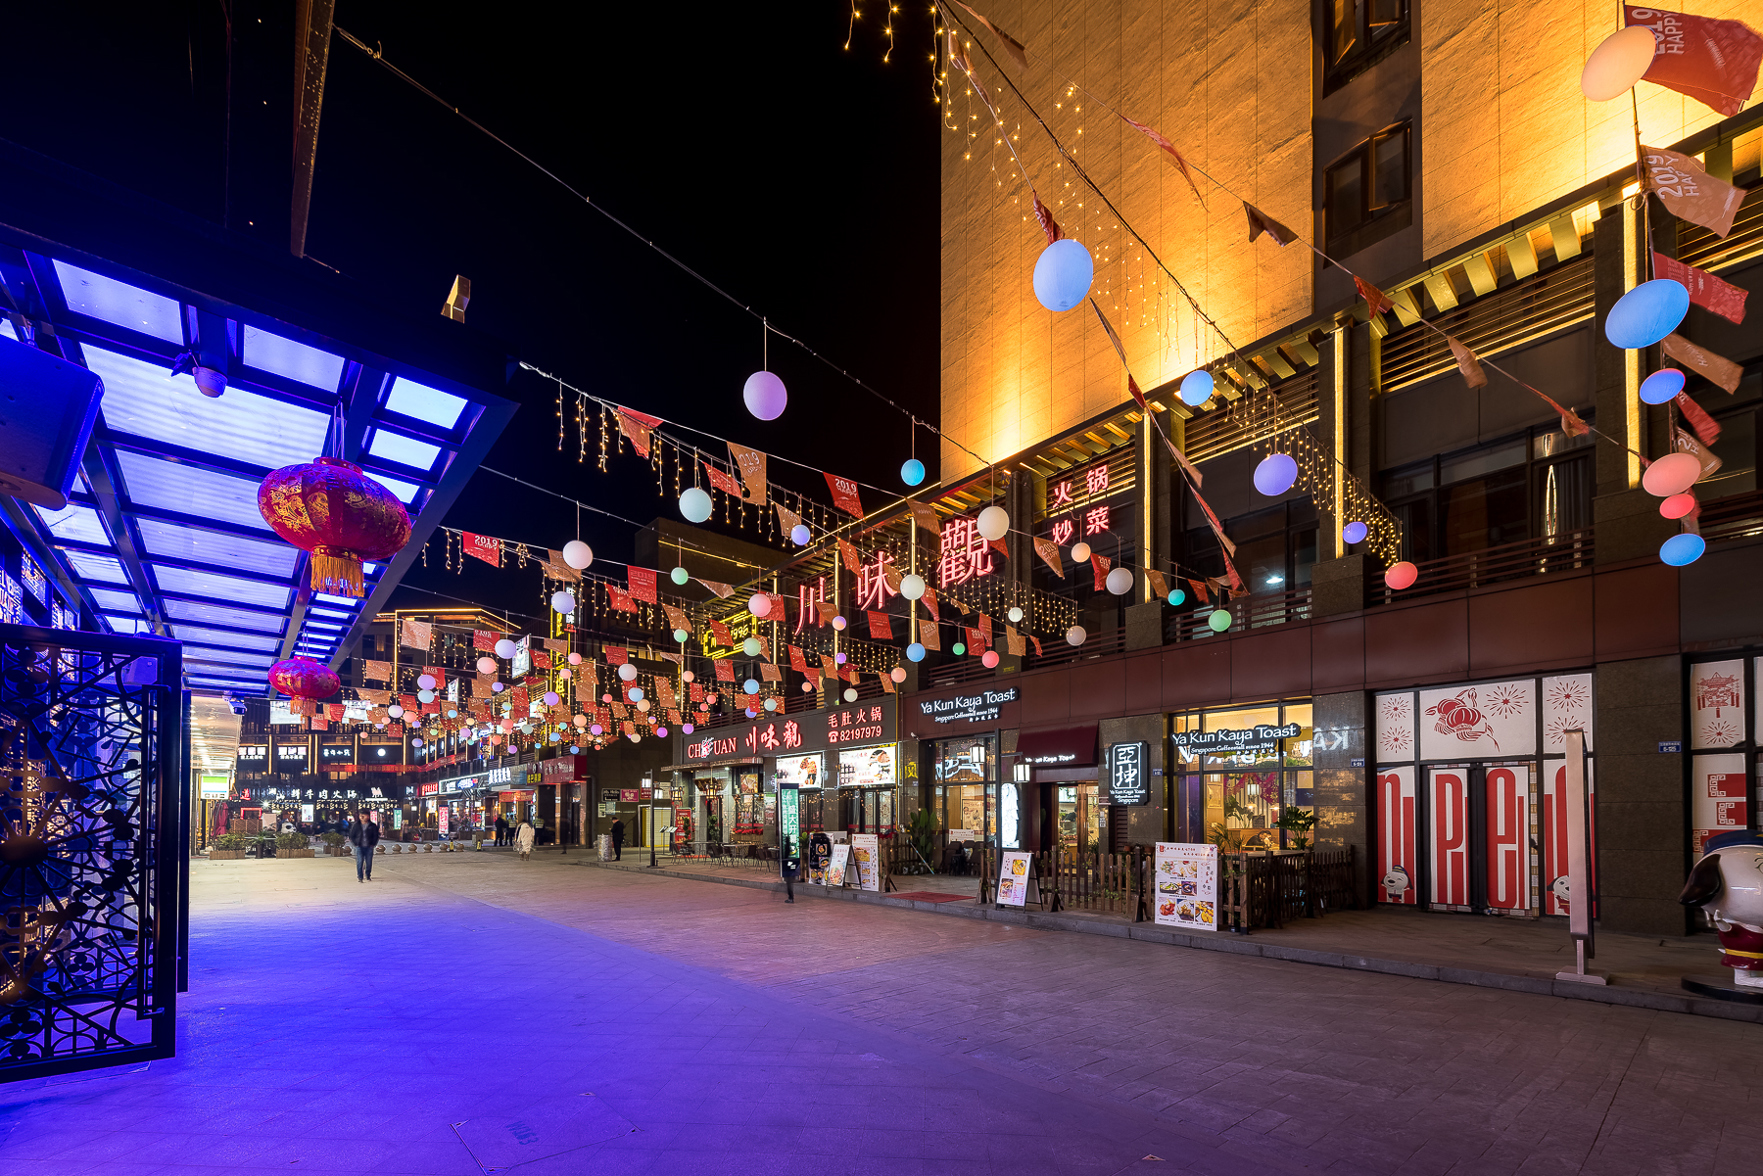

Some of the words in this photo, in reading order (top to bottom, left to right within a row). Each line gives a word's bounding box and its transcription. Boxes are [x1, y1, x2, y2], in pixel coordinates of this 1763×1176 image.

[1660, 11, 1684, 55] HAPPY
[1644, 155, 1684, 200] 2019
[835, 478, 857, 493] 2019
[1053, 465, 1109, 509] 火锅
[1052, 506, 1109, 546] 炒菜
[475, 535, 498, 547] 2019
[921, 702, 932, 714] Ya
[934, 700, 954, 712] Kun
[955, 696, 982, 712] Kaya
[983, 688, 1015, 704] Toast
[828, 706, 882, 728] 毛肚火锅
[840, 725, 882, 743] 82197979
[1172, 733, 1187, 745] Ya
[1190, 732, 1215, 744] Kun
[1218, 729, 1253, 746] Kaya
[1255, 724, 1297, 739] Toast
[1260, 741, 1274, 749] 1944
[1043, 756, 1057, 764] Kaya
[1058, 754, 1076, 762] Toast
